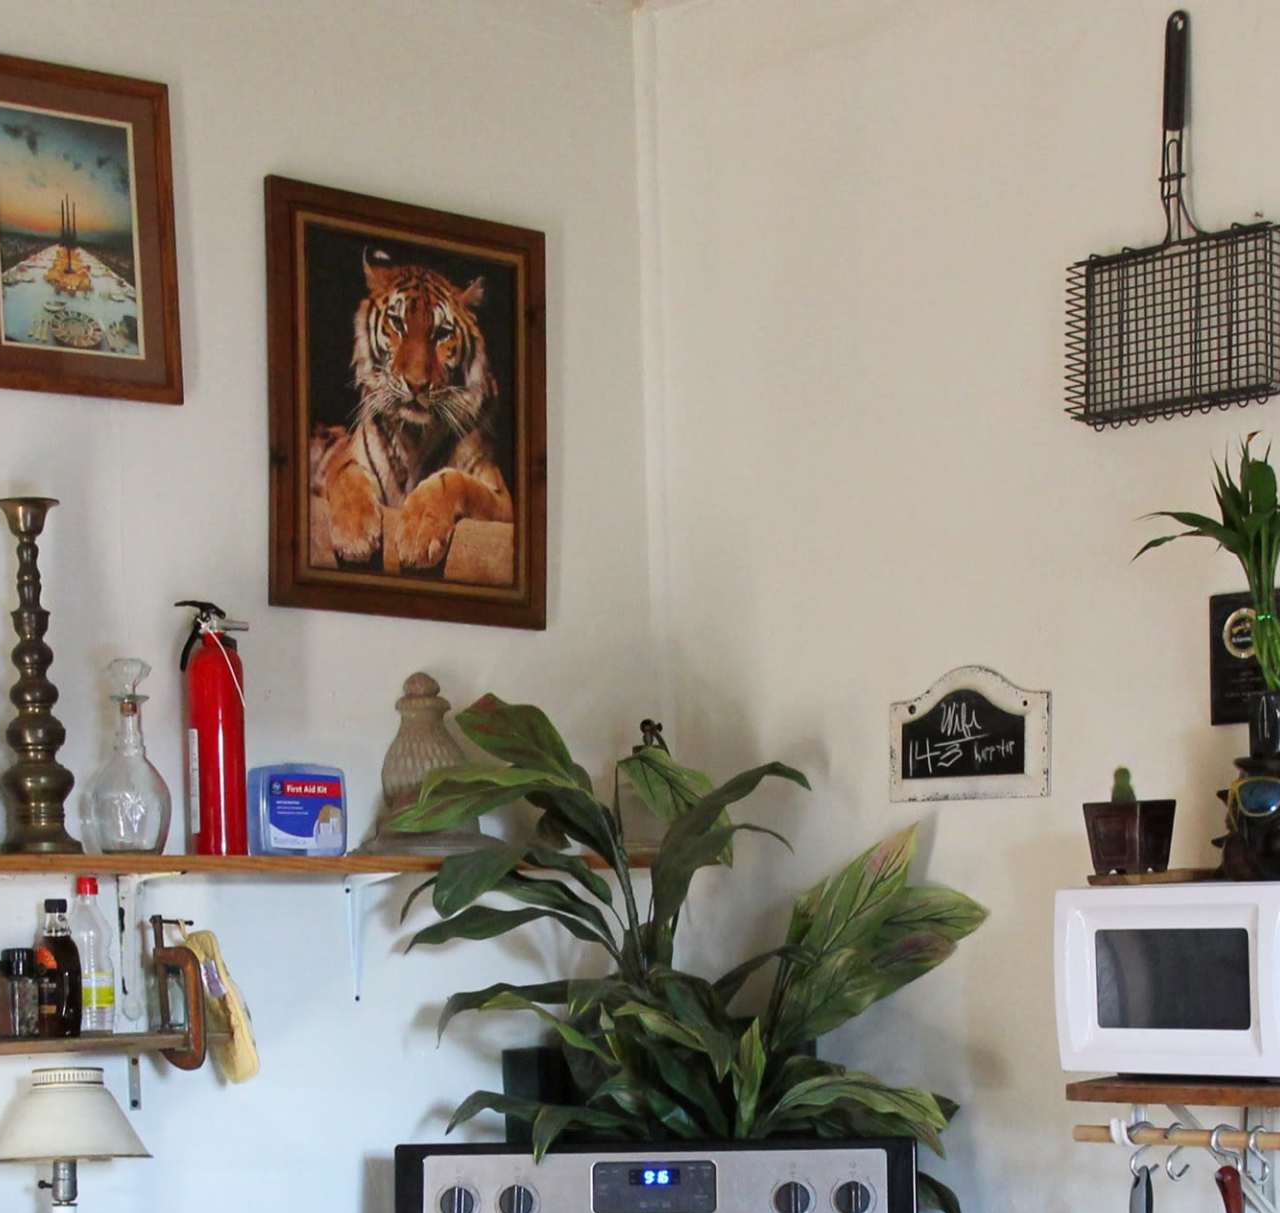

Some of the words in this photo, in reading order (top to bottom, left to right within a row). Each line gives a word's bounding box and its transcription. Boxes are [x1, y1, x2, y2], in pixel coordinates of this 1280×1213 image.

[286, 784, 302, 793] First
[304, 784, 316, 793] Aid
[317, 784, 327, 794] Kit
